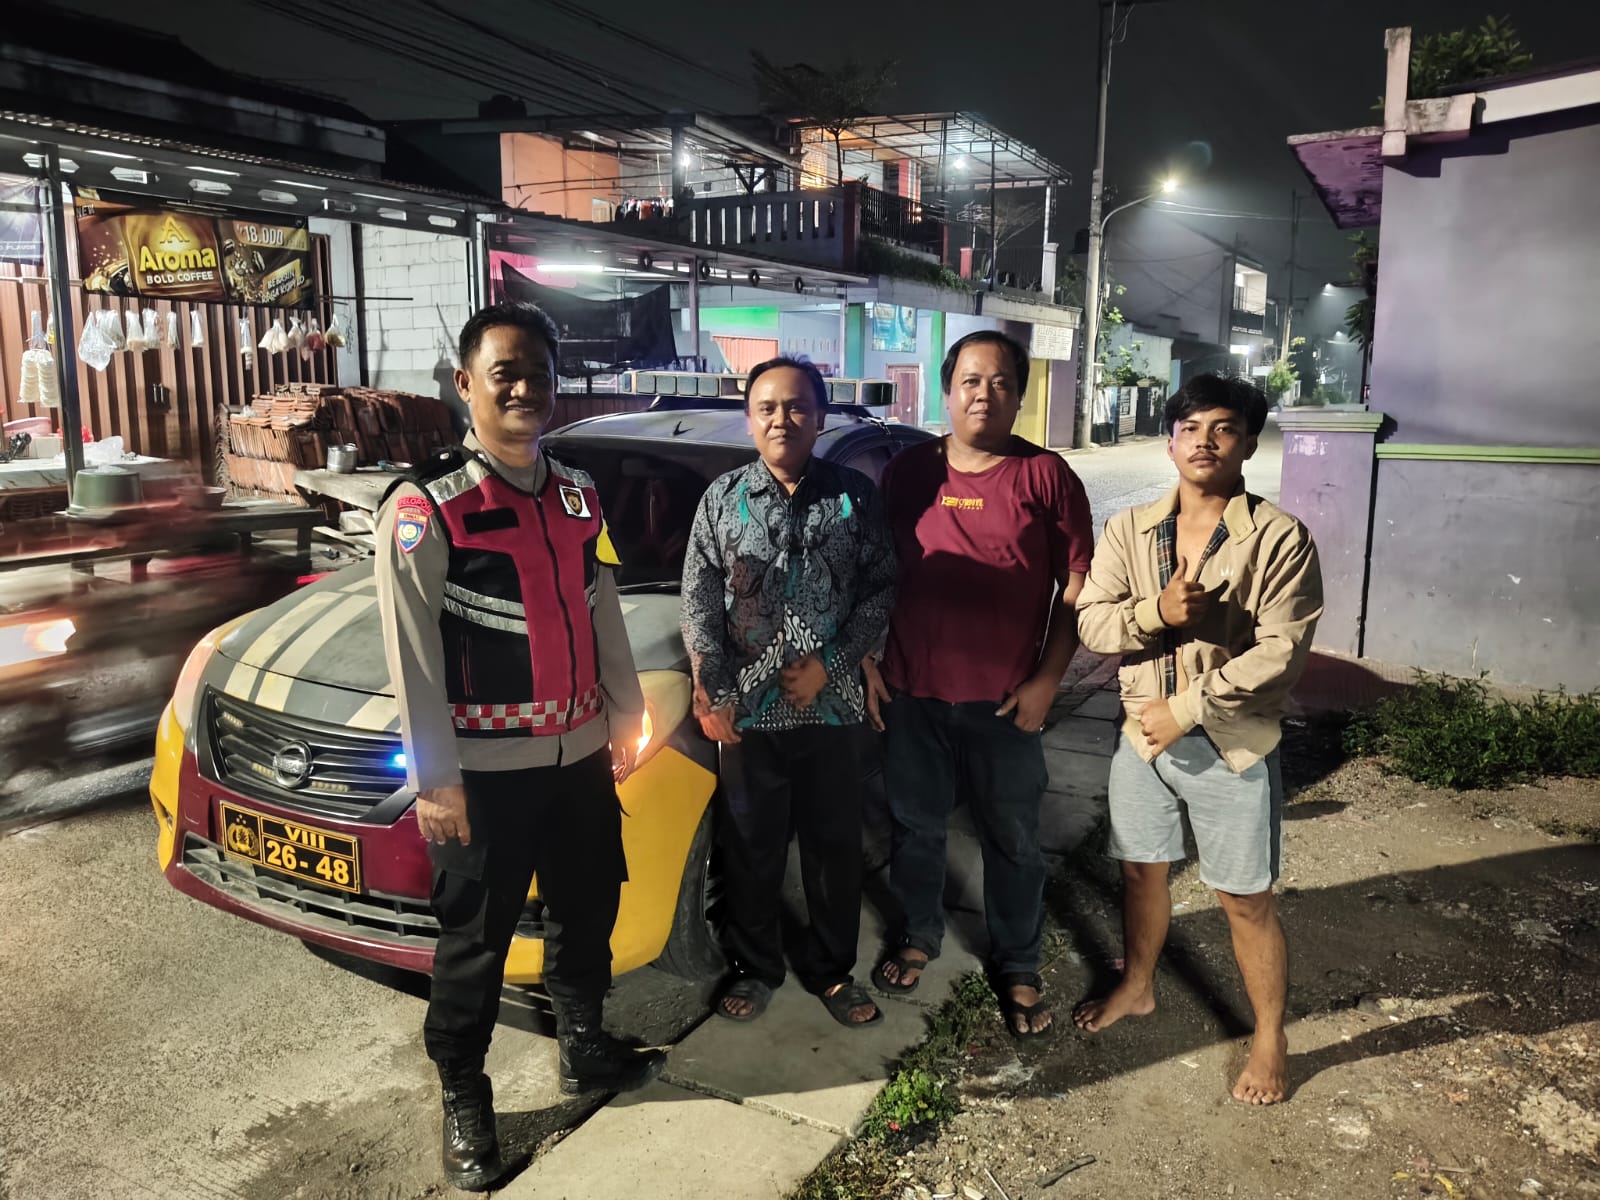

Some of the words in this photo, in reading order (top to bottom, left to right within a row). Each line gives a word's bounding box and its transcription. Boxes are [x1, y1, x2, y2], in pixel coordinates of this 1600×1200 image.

[76, 204, 95, 218] NEW
[139, 245, 217, 272] Aroma
[147, 272, 174, 285] BOLD
[178, 270, 214, 282] COFFEE
[284, 824, 325, 849] VIII
